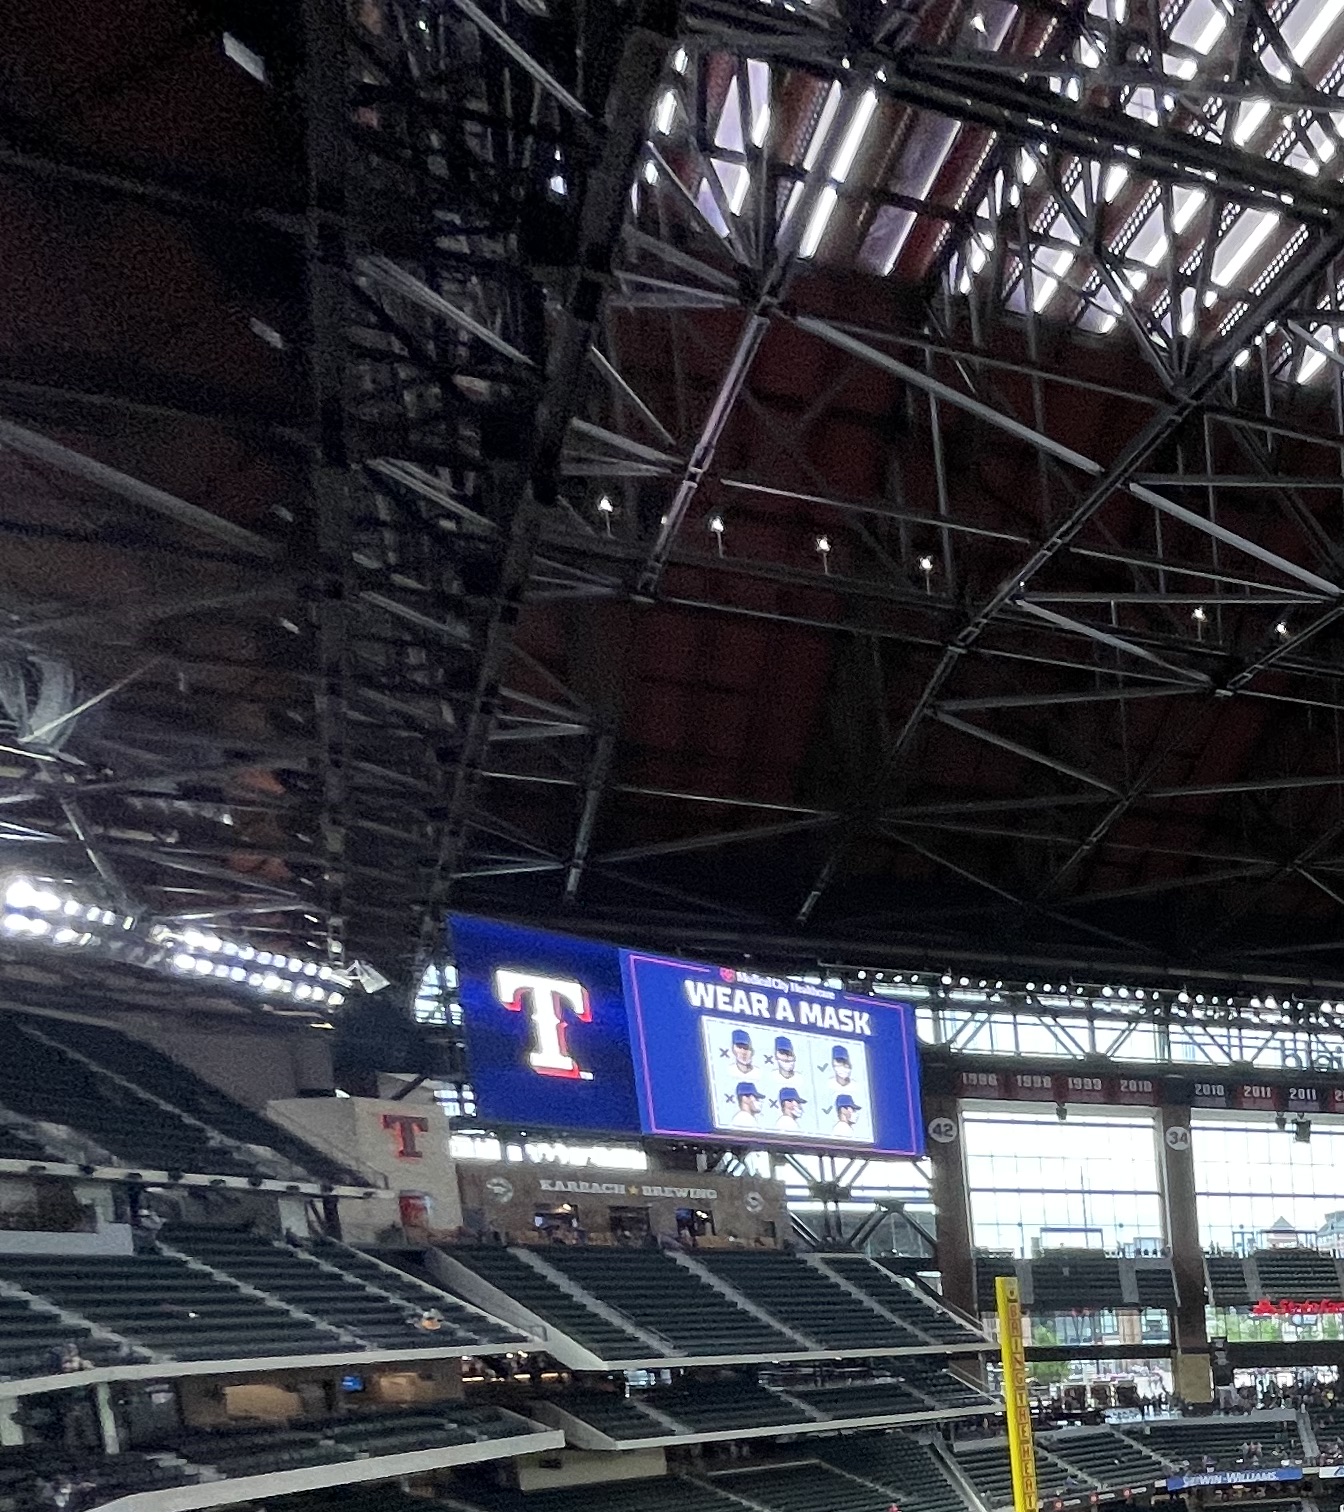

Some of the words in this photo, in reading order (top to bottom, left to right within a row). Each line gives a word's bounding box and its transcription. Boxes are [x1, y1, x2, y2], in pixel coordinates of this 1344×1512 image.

[496, 968, 593, 1079] T
[684, 979, 770, 1019] WEAR
[776, 996, 795, 1022] A
[800, 1000, 872, 1036] MASK
[382, 1114, 429, 1159] T
[932, 1122, 955, 1139] 42
[1169, 1131, 1188, 1145] 34
[540, 1179, 626, 1195] KARBACH
[642, 1185, 718, 1199] BREWING
